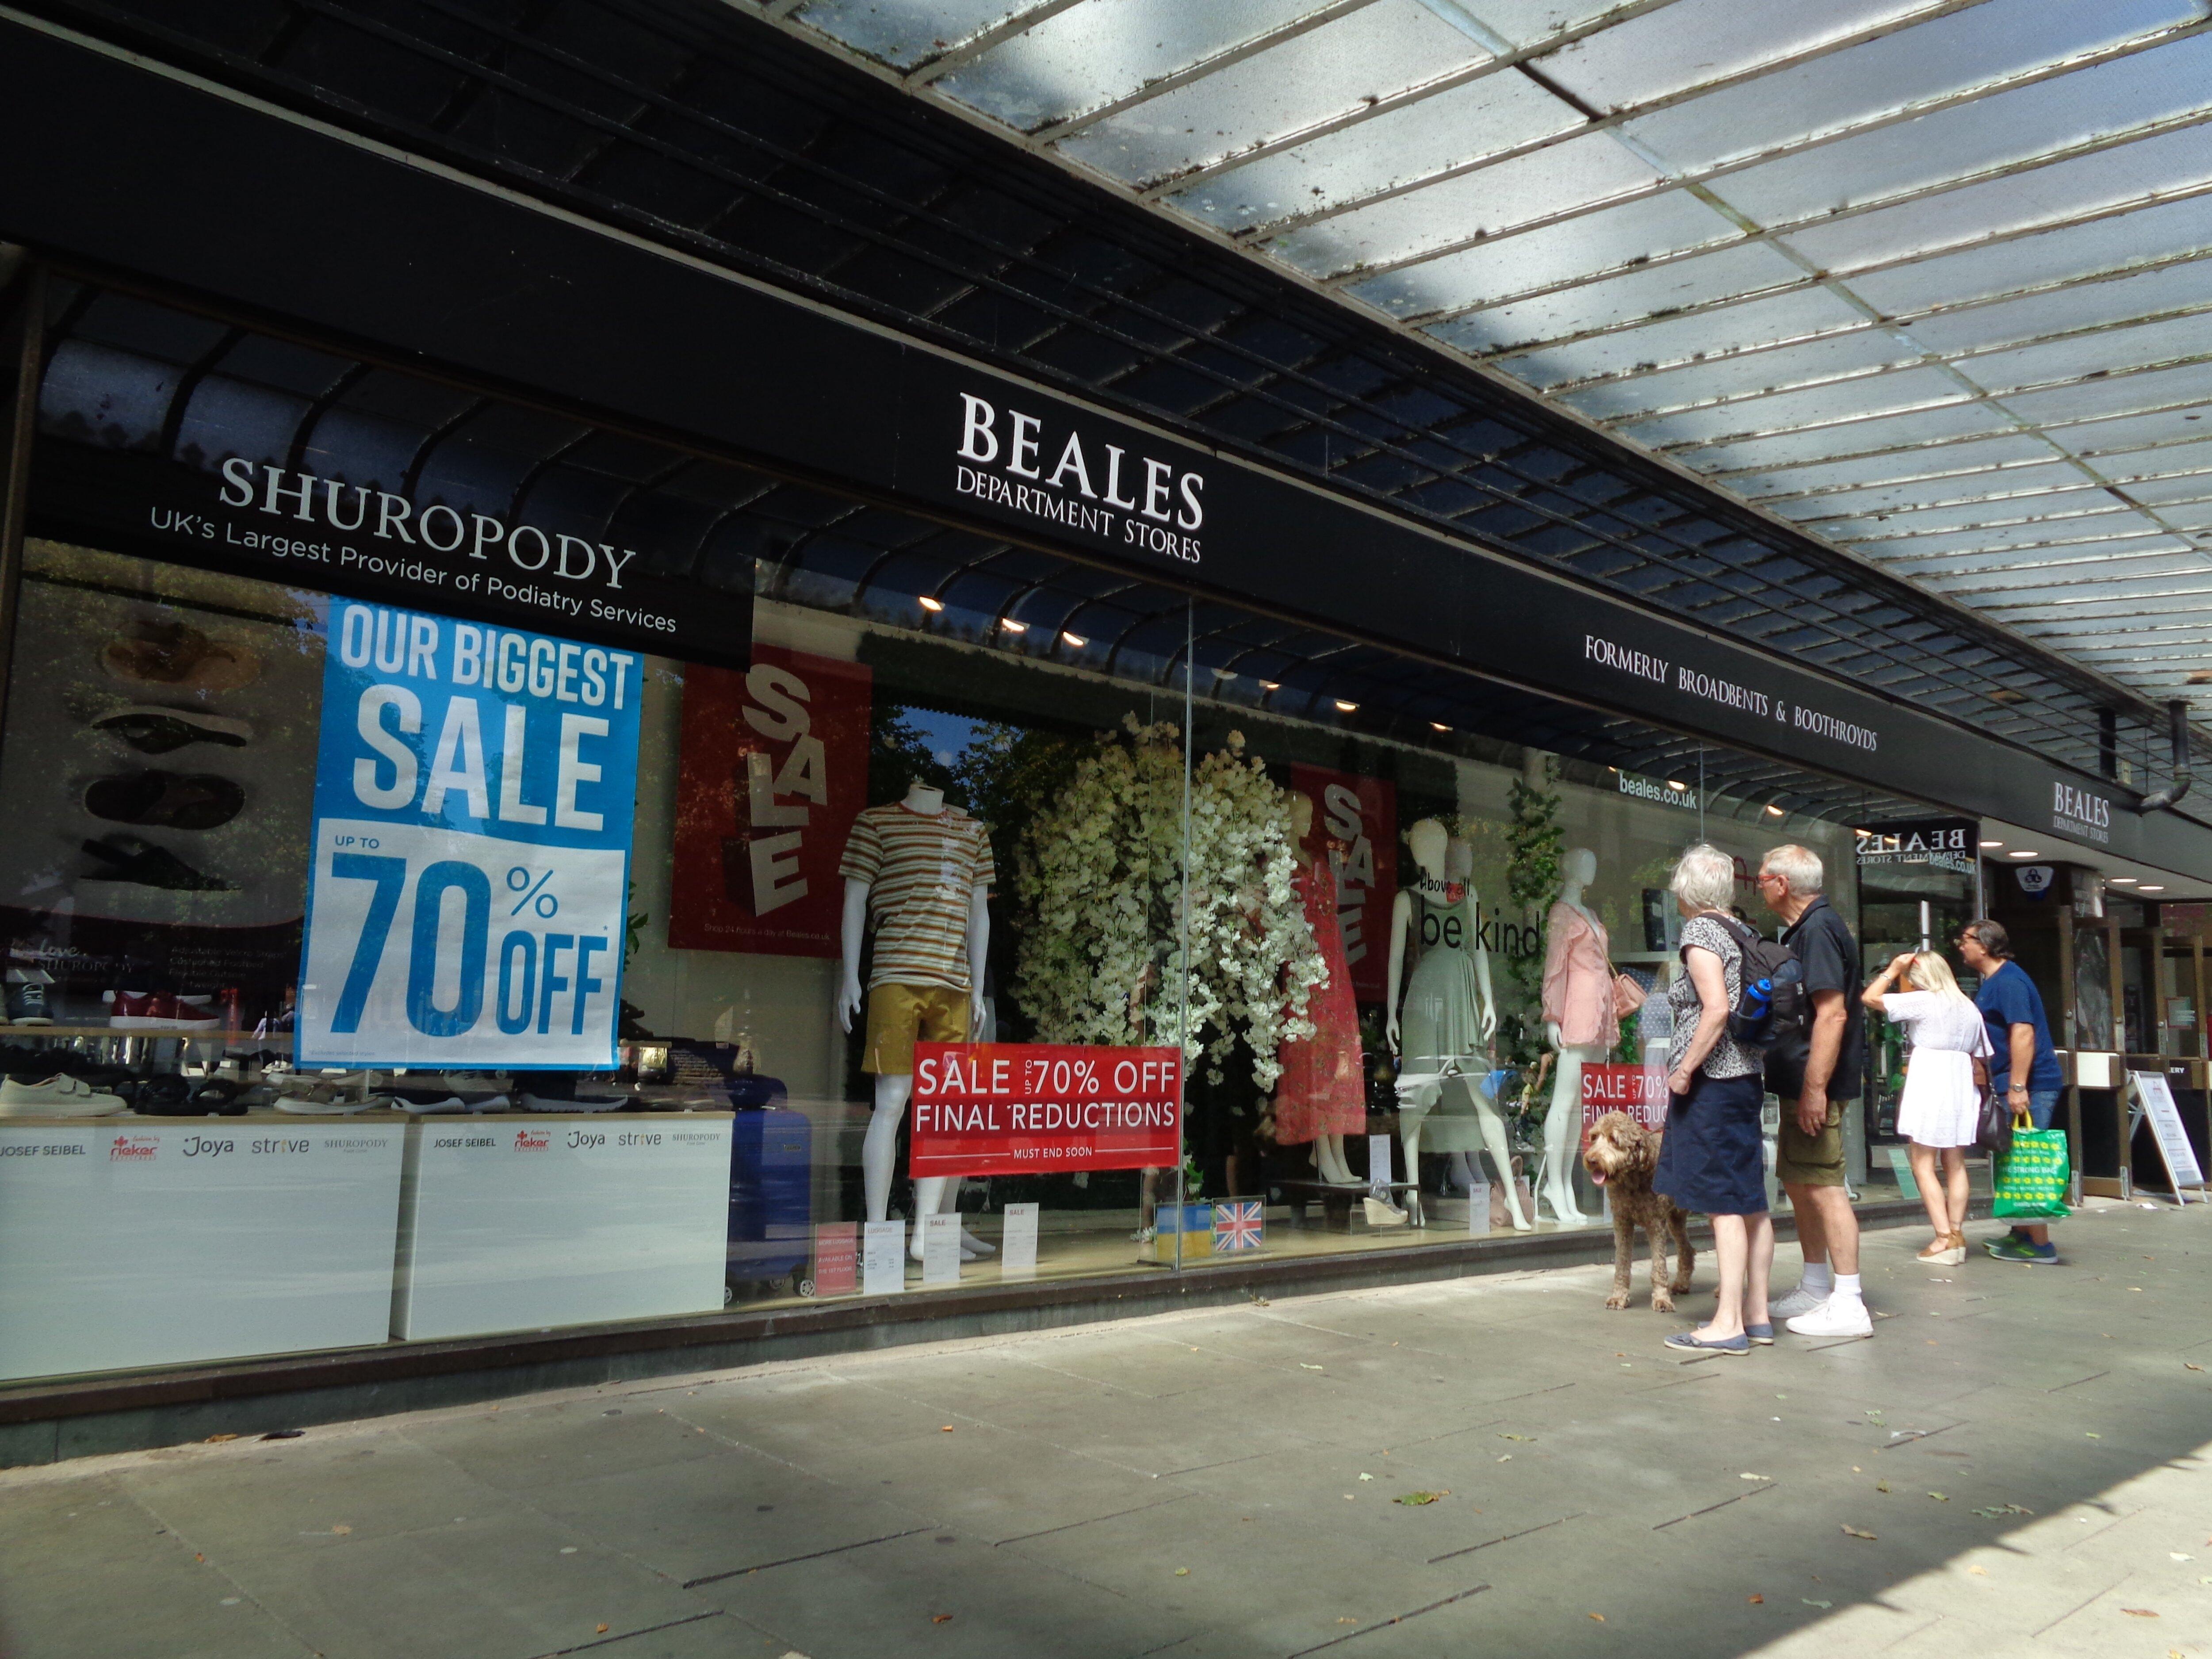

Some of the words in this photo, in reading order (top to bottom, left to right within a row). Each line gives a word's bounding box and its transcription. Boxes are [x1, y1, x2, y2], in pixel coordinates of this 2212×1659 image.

[957, 392, 1204, 531] BEALES
[220, 458, 636, 589] SHUROPODY
[956, 465, 1114, 536] DEPARTMENT
[1124, 519, 1201, 564] STORES
[151, 507, 215, 539] UK's
[226, 523, 330, 557] Largest
[341, 547, 447, 585] Provider
[455, 573, 480, 592] of
[488, 577, 583, 616] Podiatry
[590, 599, 677, 633] Services
[341, 604, 439, 680] OUR
[452, 624, 634, 710] BIGGEST
[1585, 635, 1669, 683] FORMERLY
[1679, 666, 1768, 716] BROADBENTS
[1776, 700, 1787, 723] &
[1795, 705, 1878, 752] BOOTHROYDS
[353, 684, 610, 831] SALE
[742, 663, 828, 917] SALE
[1619, 773, 1697, 810] beales.co.uk
[2053, 782, 2109, 828] BEALES
[335, 835, 355, 847] UP
[360, 837, 379, 849] TO
[2053, 815, 2089, 837] DEPARTMENT
[2090, 827, 2109, 844] STORES
[1420, 872, 1452, 893] Above
[704, 923, 723, 933] Shop
[1420, 895, 1462, 949] be
[1475, 902, 1540, 958] kind
[917, 1058, 1010, 1095] SALE
[1025, 1059, 1033, 1075] TO
[1033, 1059, 1099, 1094] 70%
[1114, 1061, 1175, 1093] OFF
[1024, 1079, 1032, 1095] UP
[1583, 1074, 1626, 1099] SALE
[1636, 1075, 1669, 1099] 70%
[916, 1104, 1001, 1132] FINAL
[1011, 1101, 1175, 1130] REDUCTIONS
[1583, 1105, 1619, 1124] FIN
[42, 1144, 86, 1156] SEIBEL
[111, 1144, 158, 1156] rieker
[183, 1137, 234, 1157] Joya
[324, 1139, 388, 1148] SHUROPODY
[434, 1139, 463, 1148] JOSEF
[466, 1138, 496, 1147] SEIBEL
[515, 1138, 549, 1147] rieker
[567, 1131, 605, 1149] Joya
[1014, 1148, 1040, 1159] MUST
[1043, 1148, 1063, 1158] END
[1066, 1147, 1093, 1158] SOON
[2013, 1166, 2040, 1174] STRONG
[2041, 1166, 2057, 1175] BAG
[818, 1254, 844, 1263] AVAILABLE
